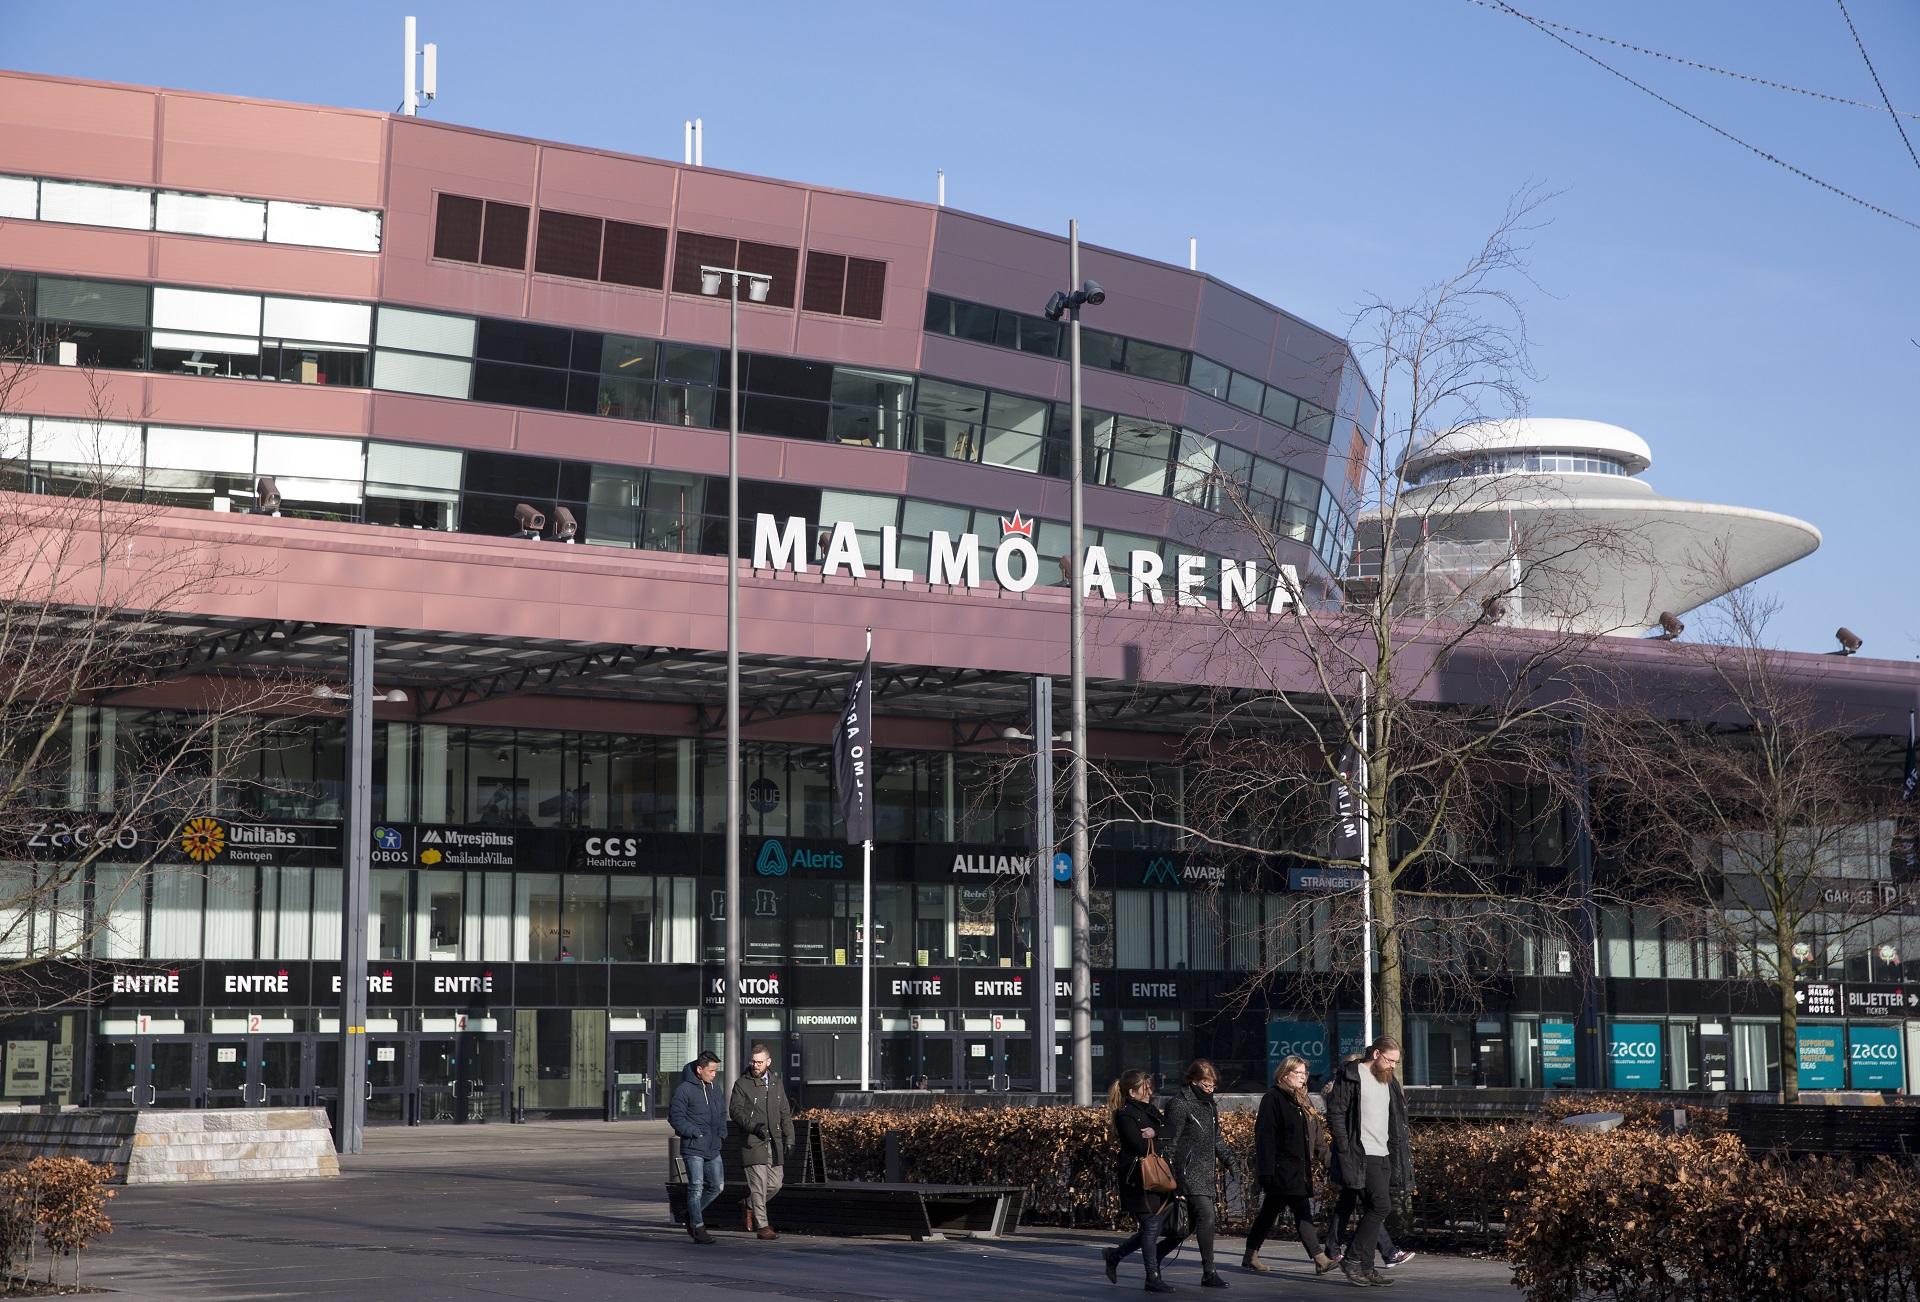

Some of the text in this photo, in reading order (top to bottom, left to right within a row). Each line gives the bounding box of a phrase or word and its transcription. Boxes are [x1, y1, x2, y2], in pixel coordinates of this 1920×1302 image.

[1083, 545, 1308, 617] ARENA
[230, 827, 296, 844] Unilabs
[444, 831, 514, 847] Myresjöhus
[229, 850, 273, 862] Röntgen
[371, 850, 409, 862] OBOS
[444, 850, 514, 865] SmålandsVillan
[586, 857, 637, 867] Healthcare
[791, 848, 843, 869] Aleris
[1824, 889, 1873, 904] GARAGE
[780, 997, 785, 1005] 2
[1808, 997, 1835, 1005] ARENA
[1848, 992, 1904, 1006] BILJETTER
[1808, 1005, 1835, 1014] HOTEL
[1865, 1007, 1889, 1015] TICKETS
[139, 1018, 147, 1032] 1
[250, 1017, 260, 1032] 2
[458, 1016, 466, 1030] 4
[797, 1015, 857, 1025] INFORMATION
[912, 1017, 919, 1029] 5
[995, 1017, 1002, 1030] 6
[1149, 1018, 1156, 1030] 8
[1799, 1047, 1826, 1055] BUSINESS
[1800, 1062, 1817, 1070] IDEAS
